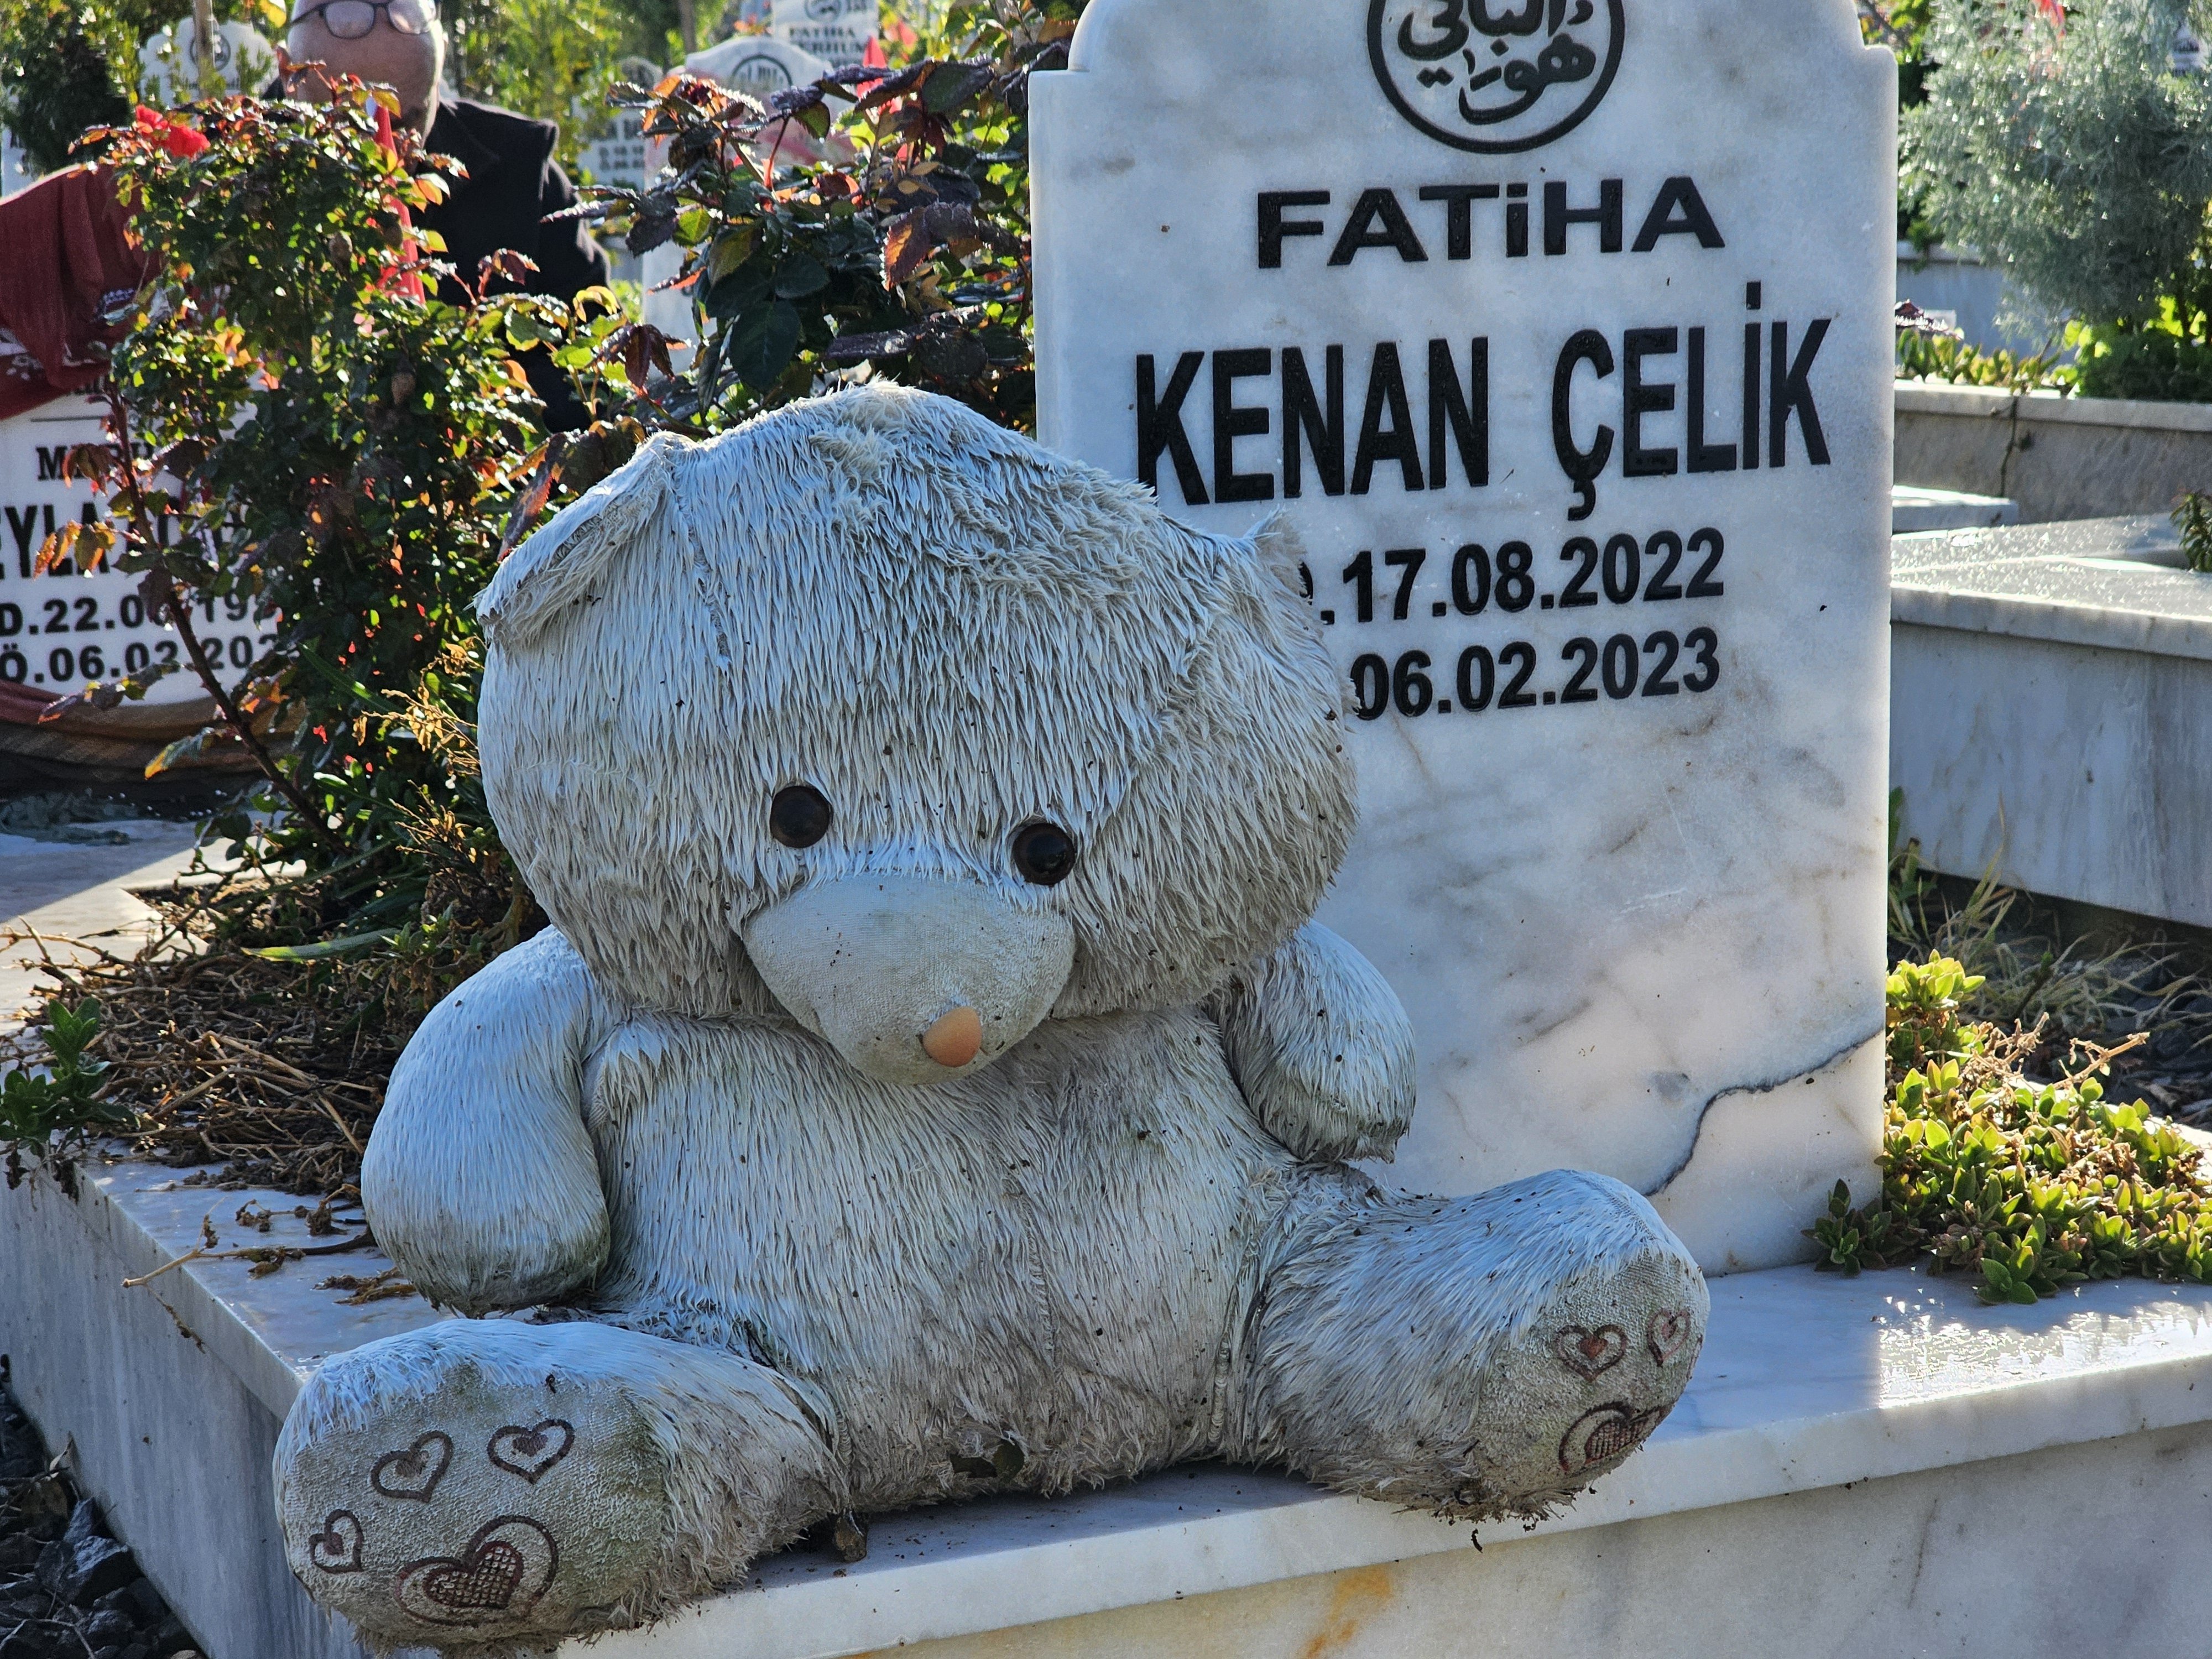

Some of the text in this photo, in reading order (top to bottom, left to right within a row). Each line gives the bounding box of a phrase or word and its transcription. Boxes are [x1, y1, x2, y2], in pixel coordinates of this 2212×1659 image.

[1136, 281, 1833, 521] KENAN ÇELİK
[0, 501, 110, 580] YLA
[1300, 527, 1725, 625] .17.08.2022
